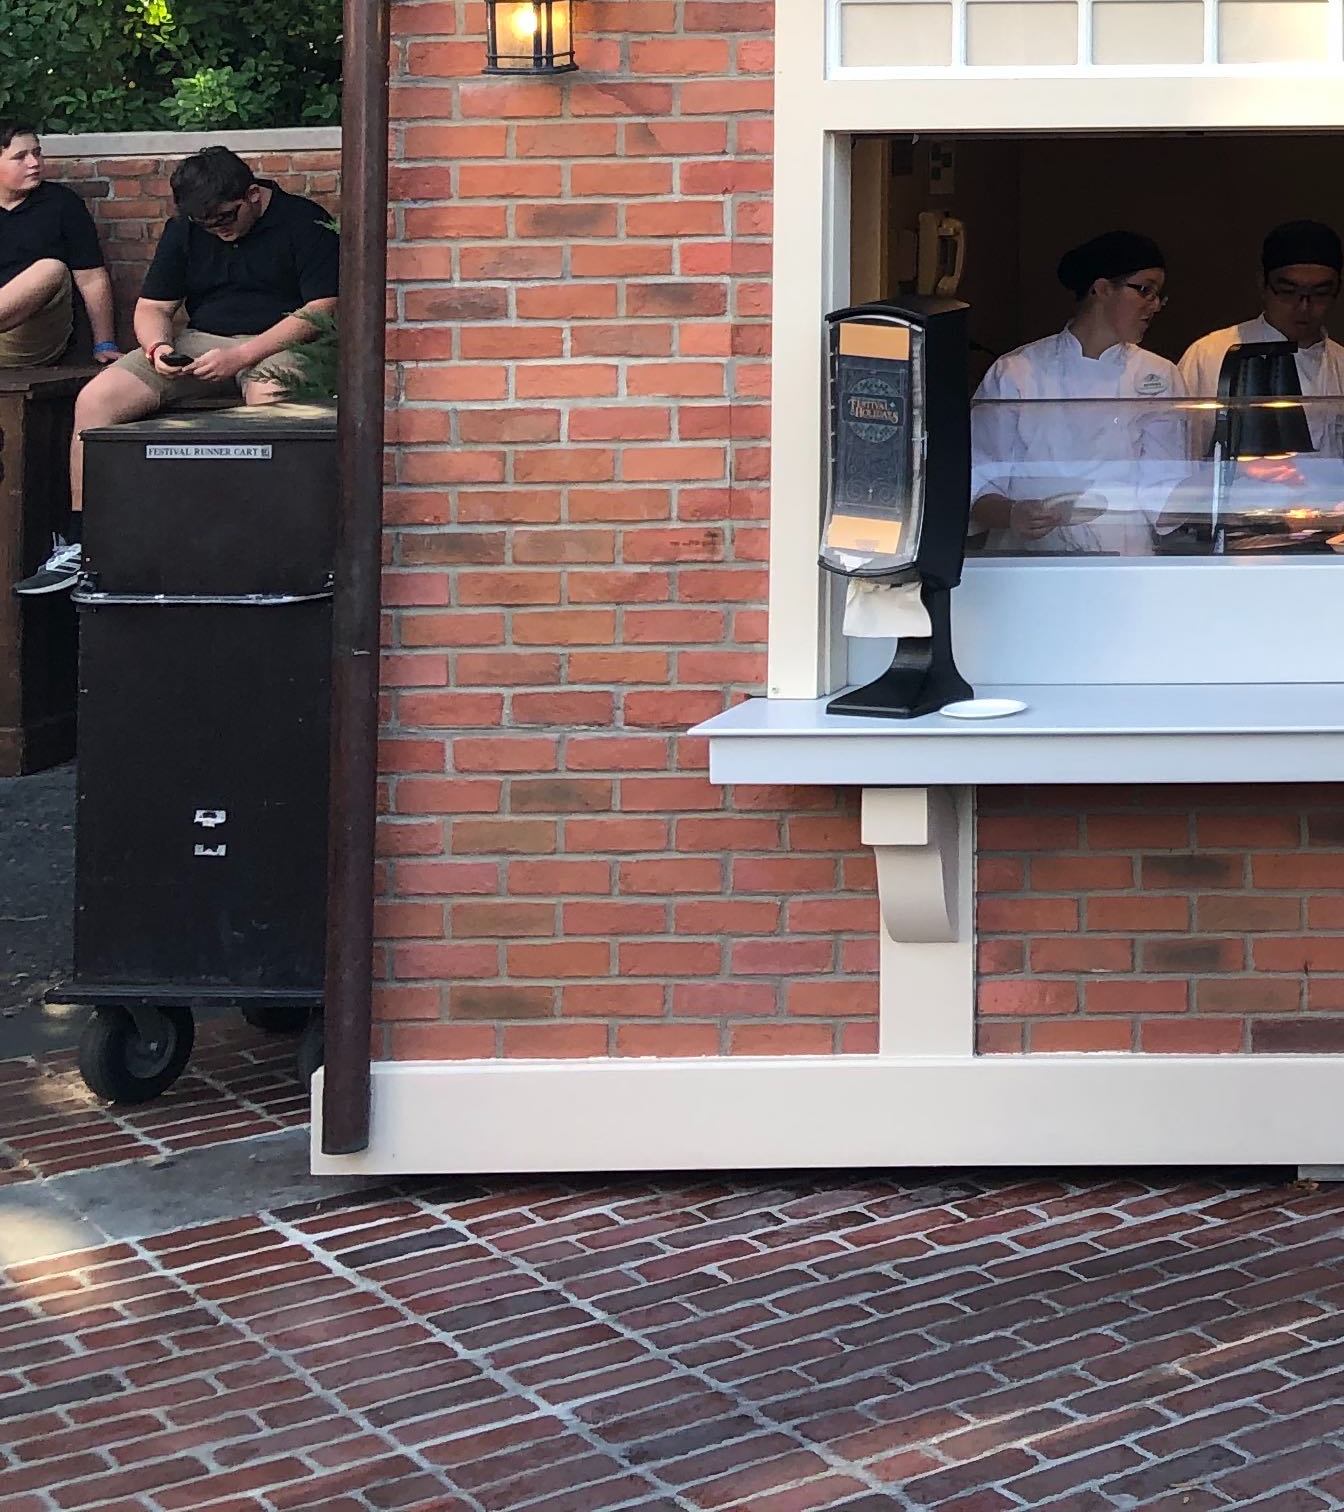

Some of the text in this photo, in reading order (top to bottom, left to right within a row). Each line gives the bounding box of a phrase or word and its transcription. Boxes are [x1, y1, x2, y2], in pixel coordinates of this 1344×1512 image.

[149, 448, 190, 456] FESTIVAL
[194, 448, 231, 456] RUNNER
[234, 448, 257, 456] CART
